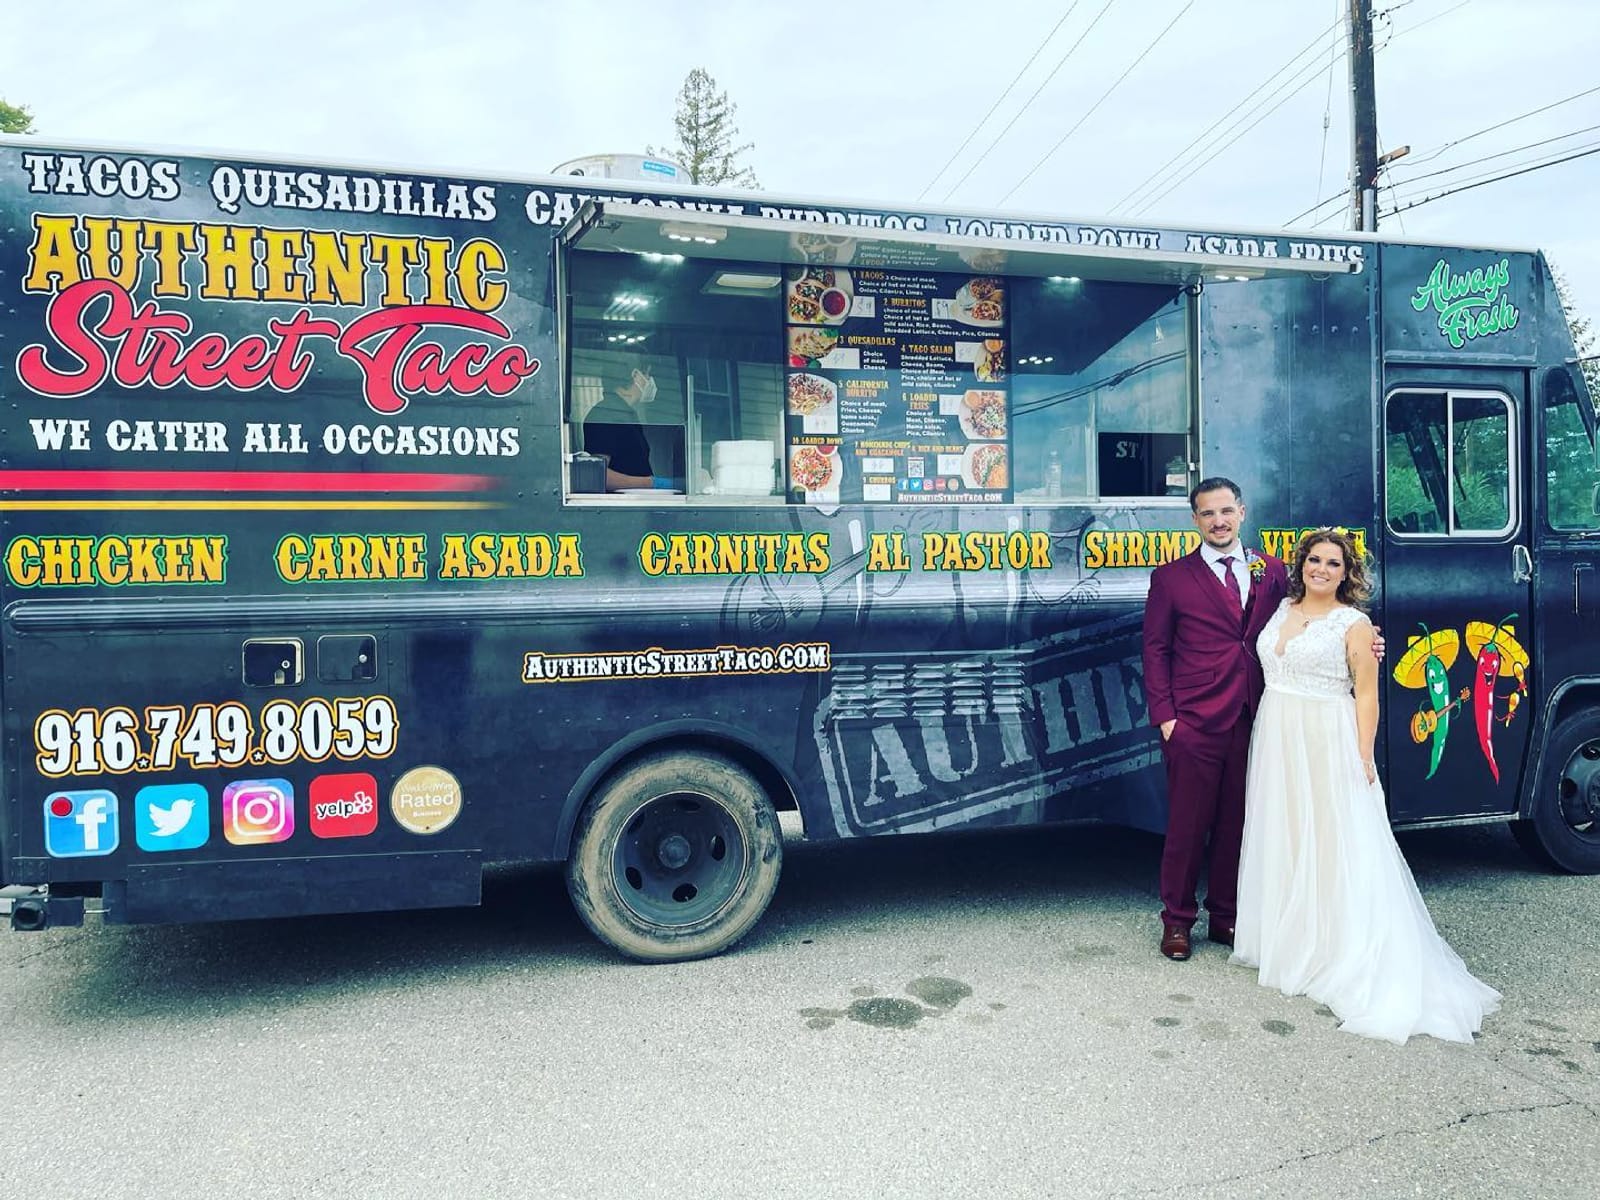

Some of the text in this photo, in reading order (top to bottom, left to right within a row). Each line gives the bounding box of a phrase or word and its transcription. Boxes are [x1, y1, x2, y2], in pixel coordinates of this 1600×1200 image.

[22, 153, 180, 198] TACOS
[210, 165, 497, 222] QUESADILLAS
[24, 214, 508, 313] AUTHENTIC
[861, 271, 884, 279] TACOS
[891, 298, 926, 308] BURRITOS
[1411, 258, 1520, 348] Always Fresh
[16, 278, 541, 415] Street Taco
[847, 335, 896, 346] QUESADILLAS
[908, 344, 928, 353] TACO
[929, 345, 953, 354] SALAD
[846, 379, 889, 389] CALIFORNIA
[910, 393, 938, 402] LOADED
[29, 418, 520, 457] WE CATER ALL OCCASIONS
[4, 532, 585, 588] CHICKEN CARNE ASADA
[638, 530, 1052, 578] CARNITAS AL PASTOR
[316, 800, 355, 819] yelp
[400, 791, 455, 809] Rated
